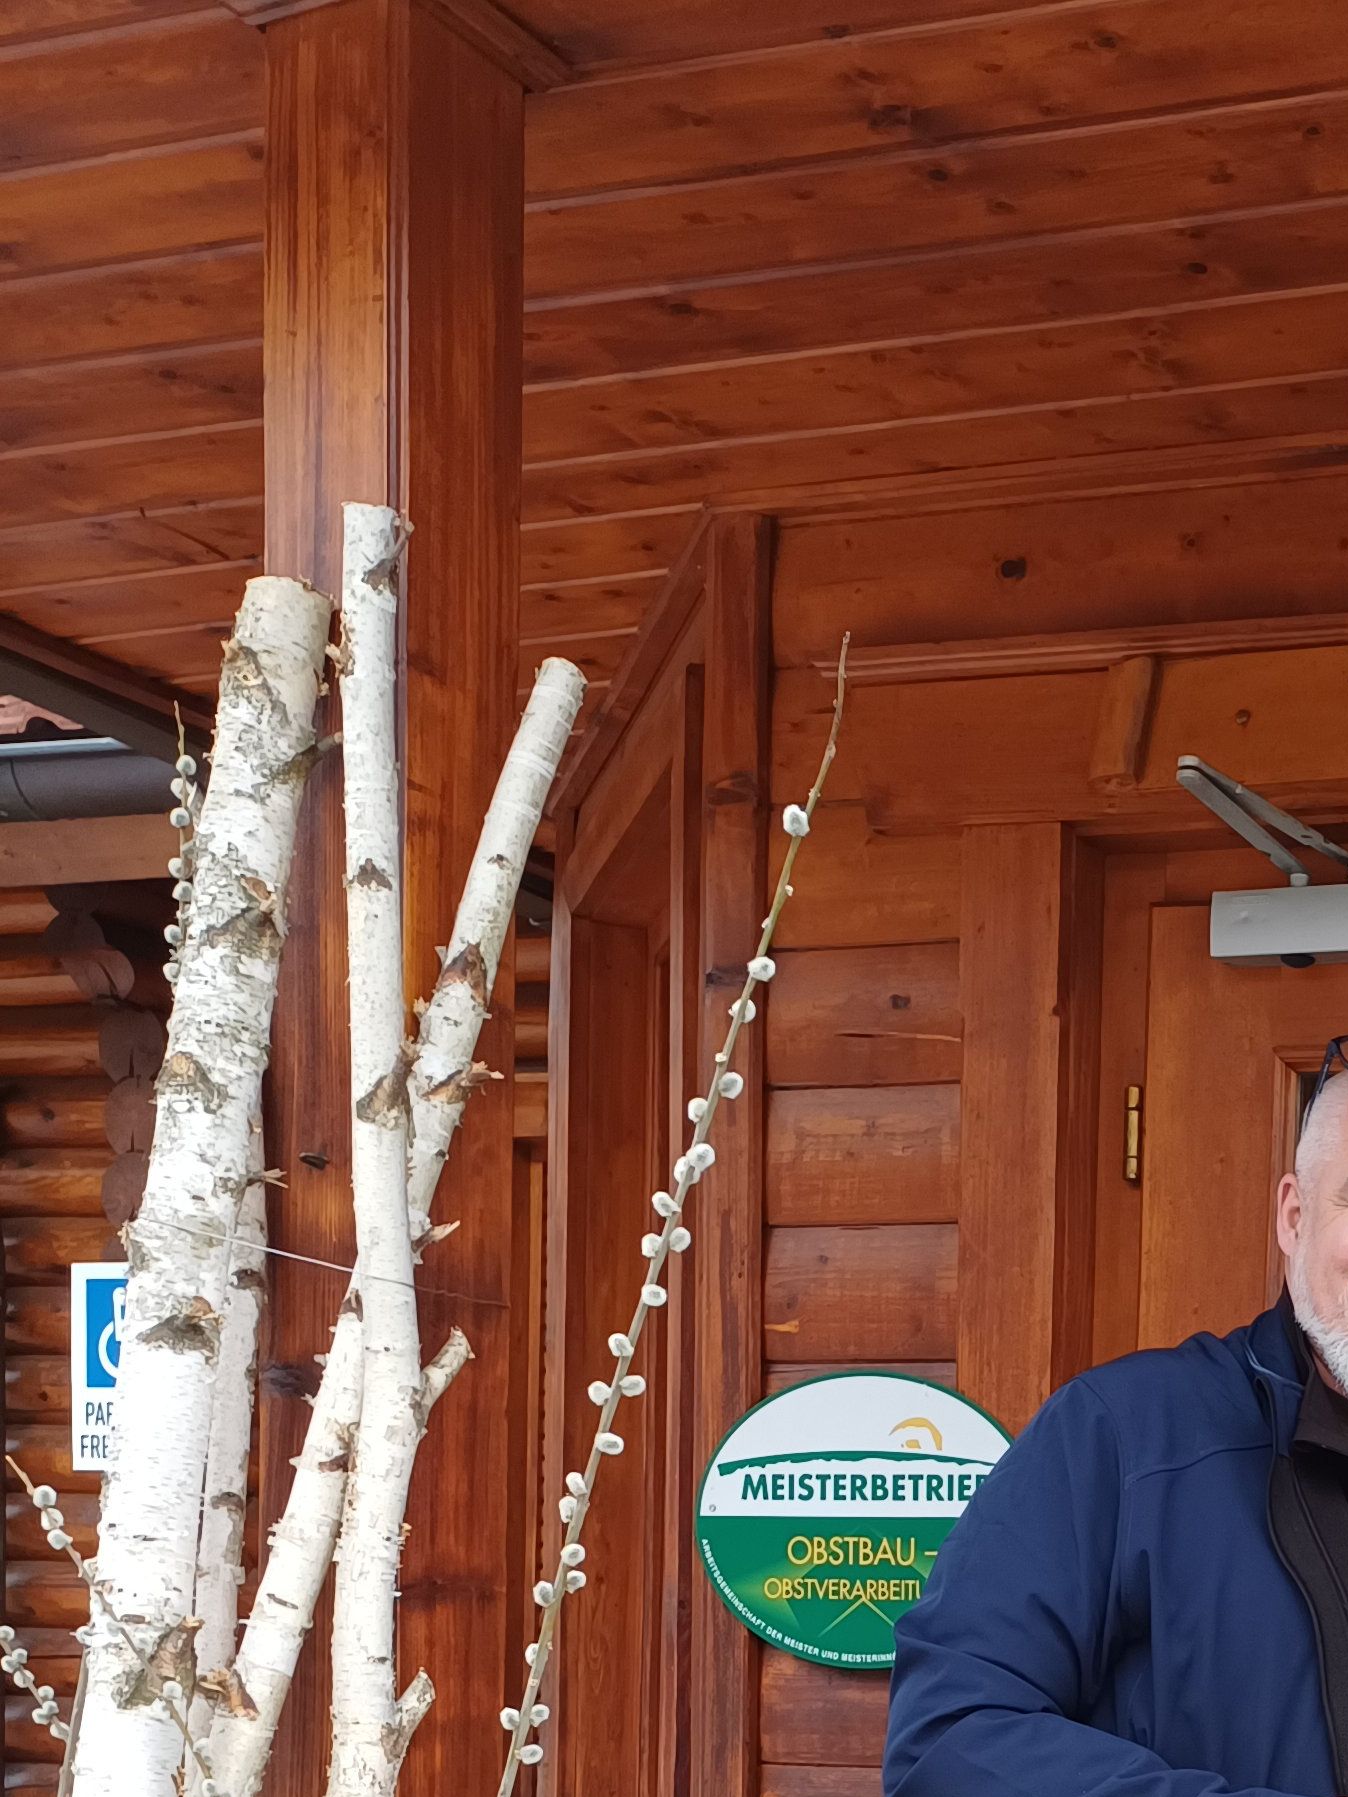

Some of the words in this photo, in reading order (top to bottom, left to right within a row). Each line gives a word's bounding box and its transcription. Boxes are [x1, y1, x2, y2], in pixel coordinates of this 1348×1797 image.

[787, 1535, 915, 1566] OBSTBAU
[783, 1635, 820, 1657] MEISTER
[821, 1649, 839, 1661] UND
